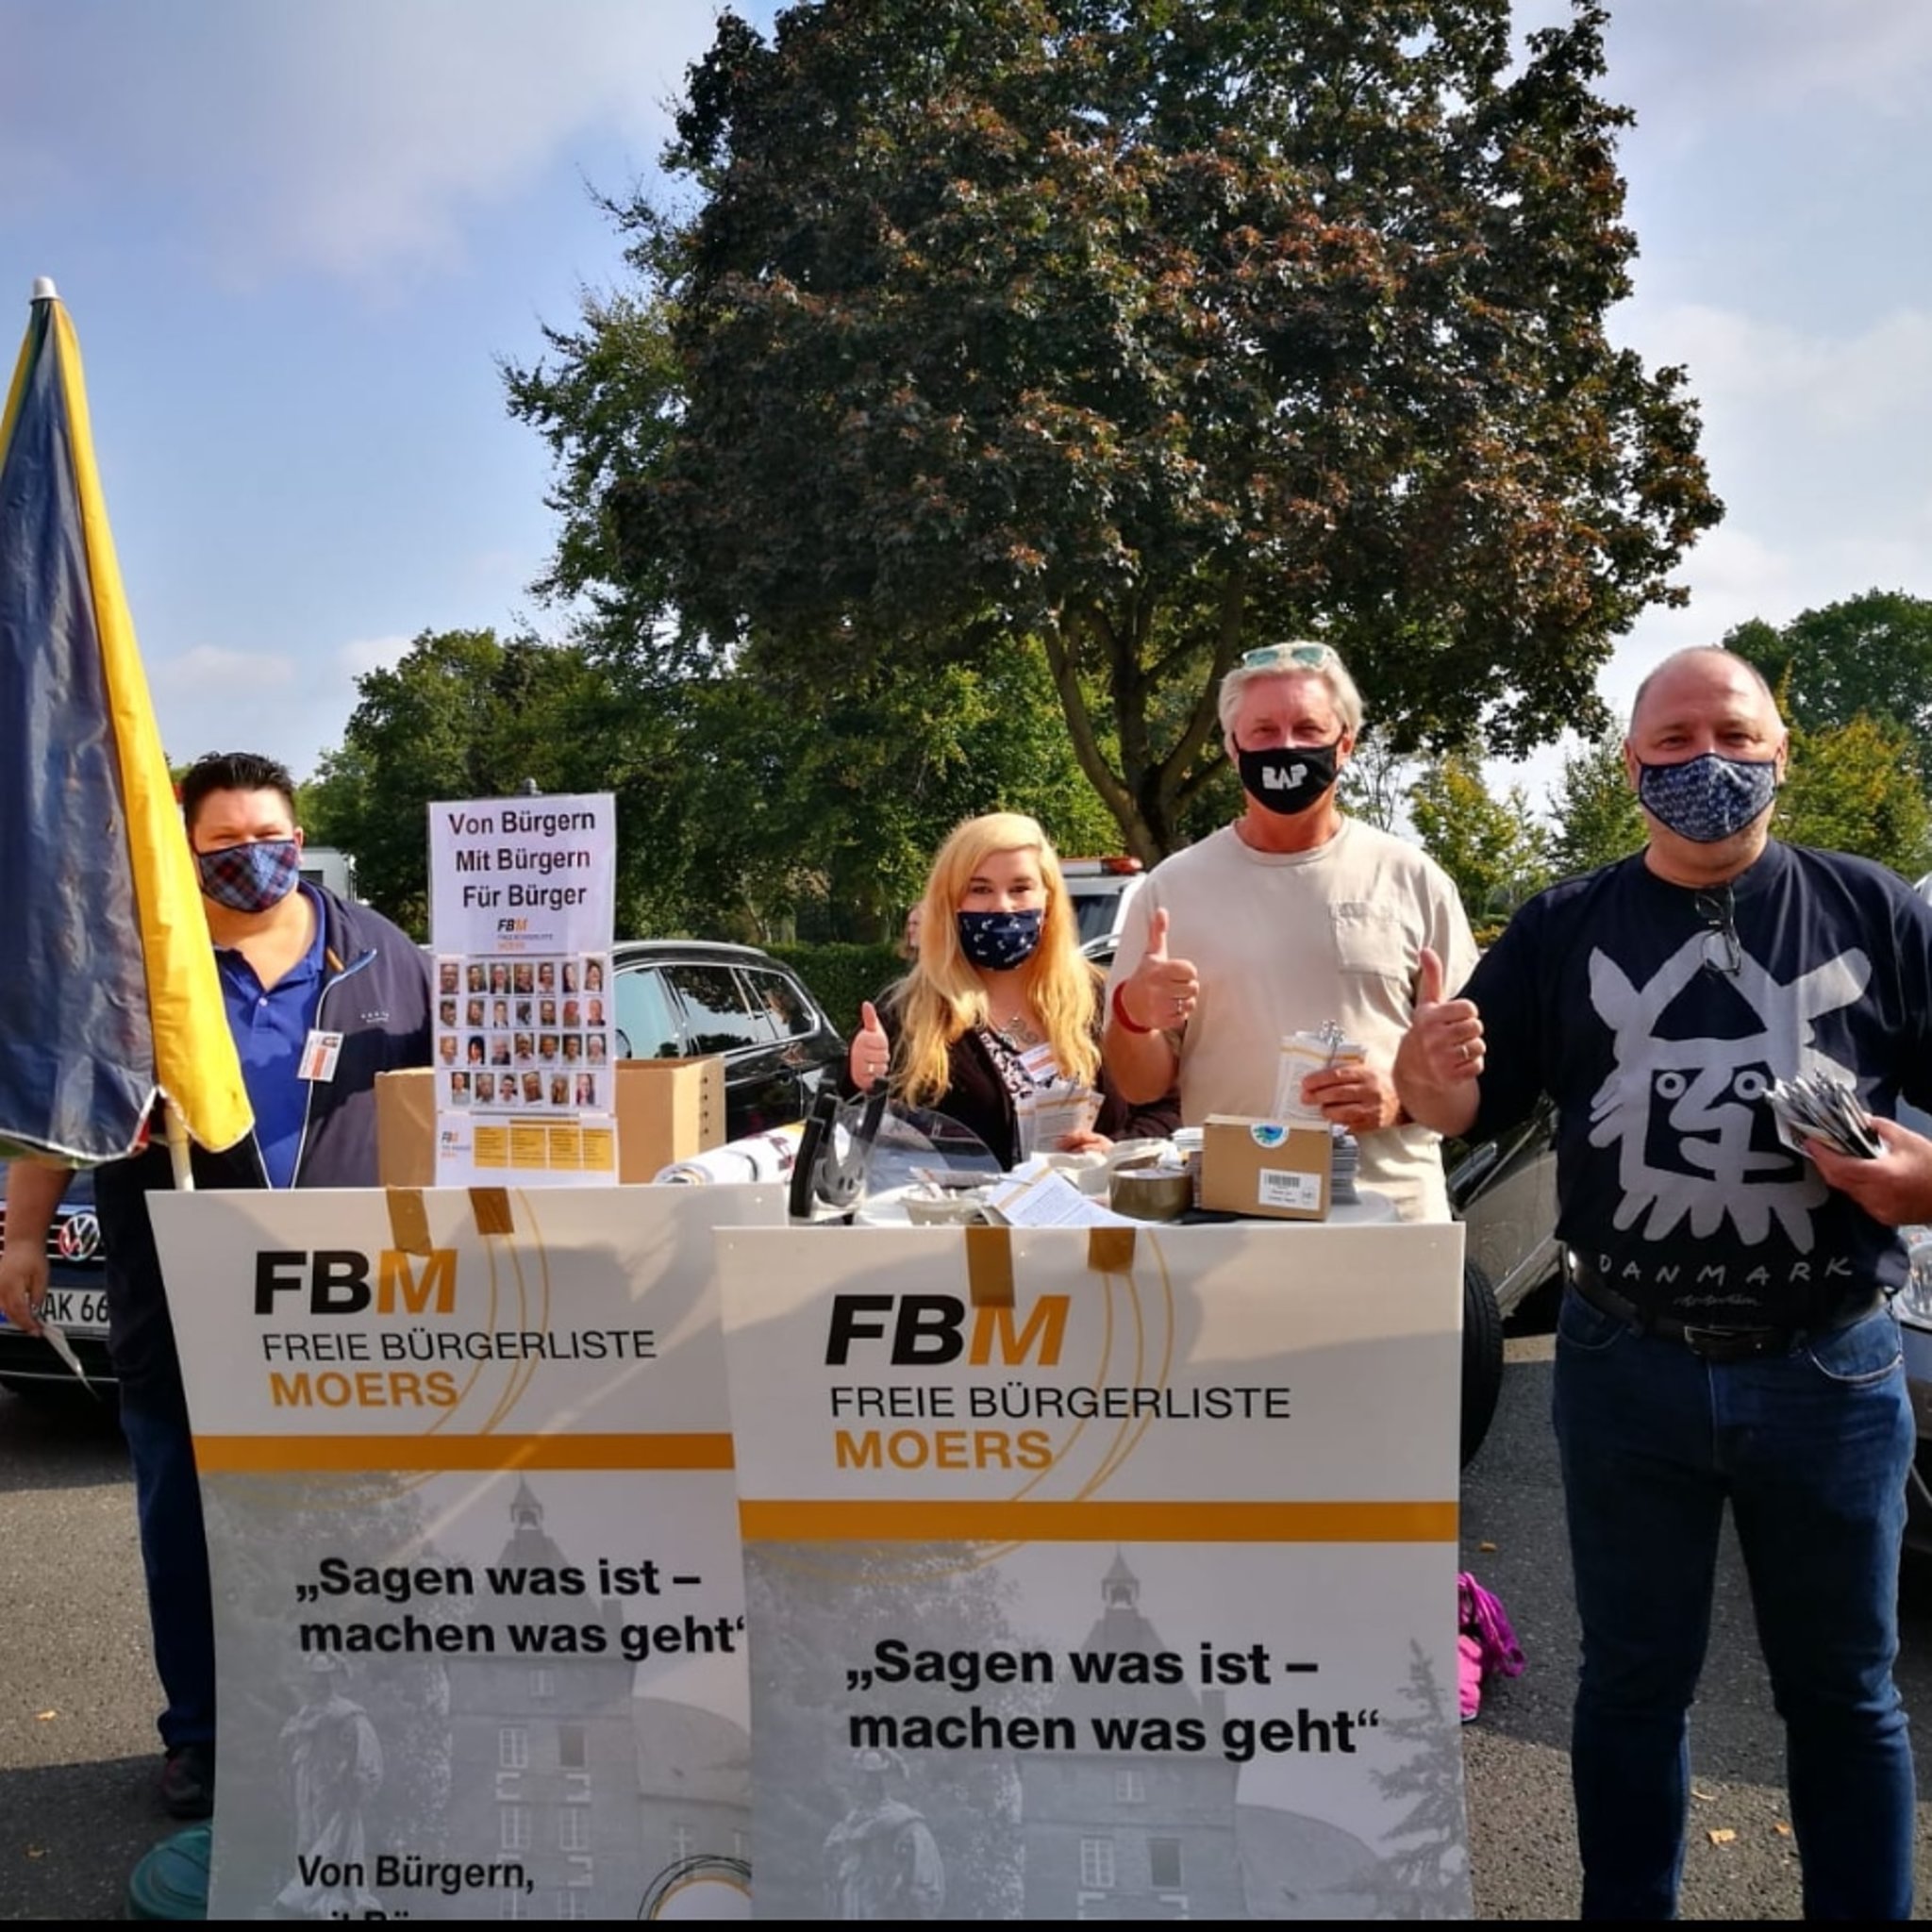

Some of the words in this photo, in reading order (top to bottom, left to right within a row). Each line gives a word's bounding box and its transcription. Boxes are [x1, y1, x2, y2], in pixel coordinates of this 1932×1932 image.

[448, 813, 493, 835] Von
[502, 810, 595, 838] Bürgern
[456, 849, 491, 872] Mit
[497, 847, 591, 875] Bürgern
[463, 885, 501, 908] Für
[508, 884, 587, 911] Bürger
[254, 1249, 458, 1315] FBM
[1599, 1253, 1852, 1287] DANMARK
[261, 1332, 372, 1362] FREIE
[382, 1326, 658, 1361] BÜRGERLISTE
[824, 1294, 1071, 1366] FBM
[269, 1371, 459, 1408] MOERS
[830, 1386, 956, 1418] FREIE
[969, 1381, 1291, 1420] BÜRGERLISTE
[835, 1429, 1054, 1470] MOERS
[296, 1557, 474, 1604] „Sagen
[486, 1566, 586, 1596] was
[598, 1558, 660, 1595] ist
[299, 1616, 495, 1653] machen
[507, 1624, 608, 1654] was
[846, 1639, 1054, 1692] „Sagen
[1069, 1651, 1184, 1685] was
[1201, 1642, 1271, 1685] ist
[849, 1706, 1075, 1751] machen
[1091, 1717, 1207, 1752] was
[298, 1855, 364, 1888] Von
[376, 1855, 534, 1895] Bürgern,
